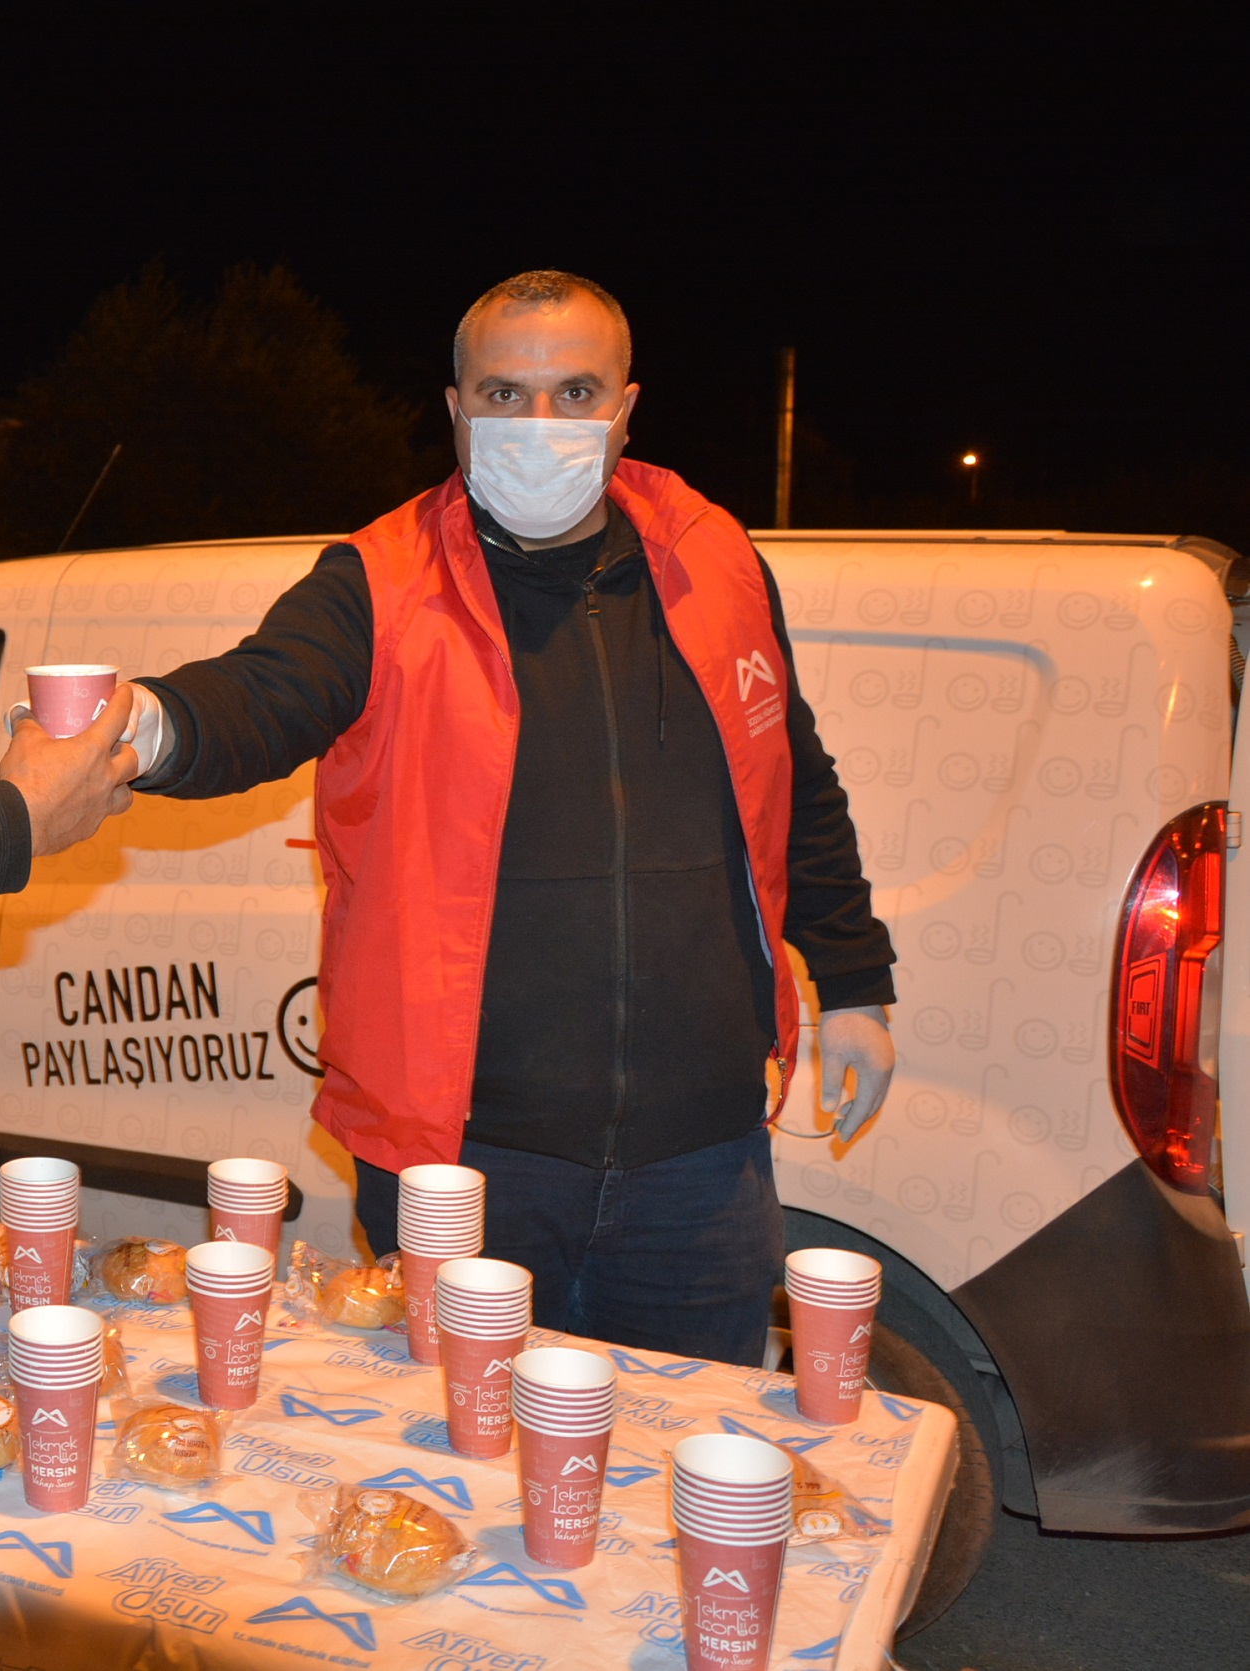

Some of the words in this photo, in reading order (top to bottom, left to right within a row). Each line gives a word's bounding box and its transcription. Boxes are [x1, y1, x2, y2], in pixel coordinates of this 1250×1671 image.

[54, 961, 220, 1026] CANDAN
[1131, 1000, 1151, 1016] FIAT
[21, 1031, 275, 1089] PAYLAŞIYORUZ
[14, 1269, 51, 1284] ekmek
[334, 1354, 421, 1378] Afiyet
[477, 1413, 510, 1426] MERS
[32, 1436, 78, 1451] ekmek
[231, 1436, 333, 1467] Afiyet
[31, 1464, 77, 1477] MERSİN
[241, 1453, 334, 1488] Olsun
[32, 1475, 54, 1492] Vahap
[554, 1529, 580, 1545] Vahap
[117, 1559, 217, 1593] Afiyet
[121, 1586, 219, 1627] Olsun
[701, 1601, 759, 1621] ekmek
[414, 1632, 538, 1671] Afiyet
[699, 1633, 757, 1652] MERSİN
[700, 1646, 729, 1669] Vahap
